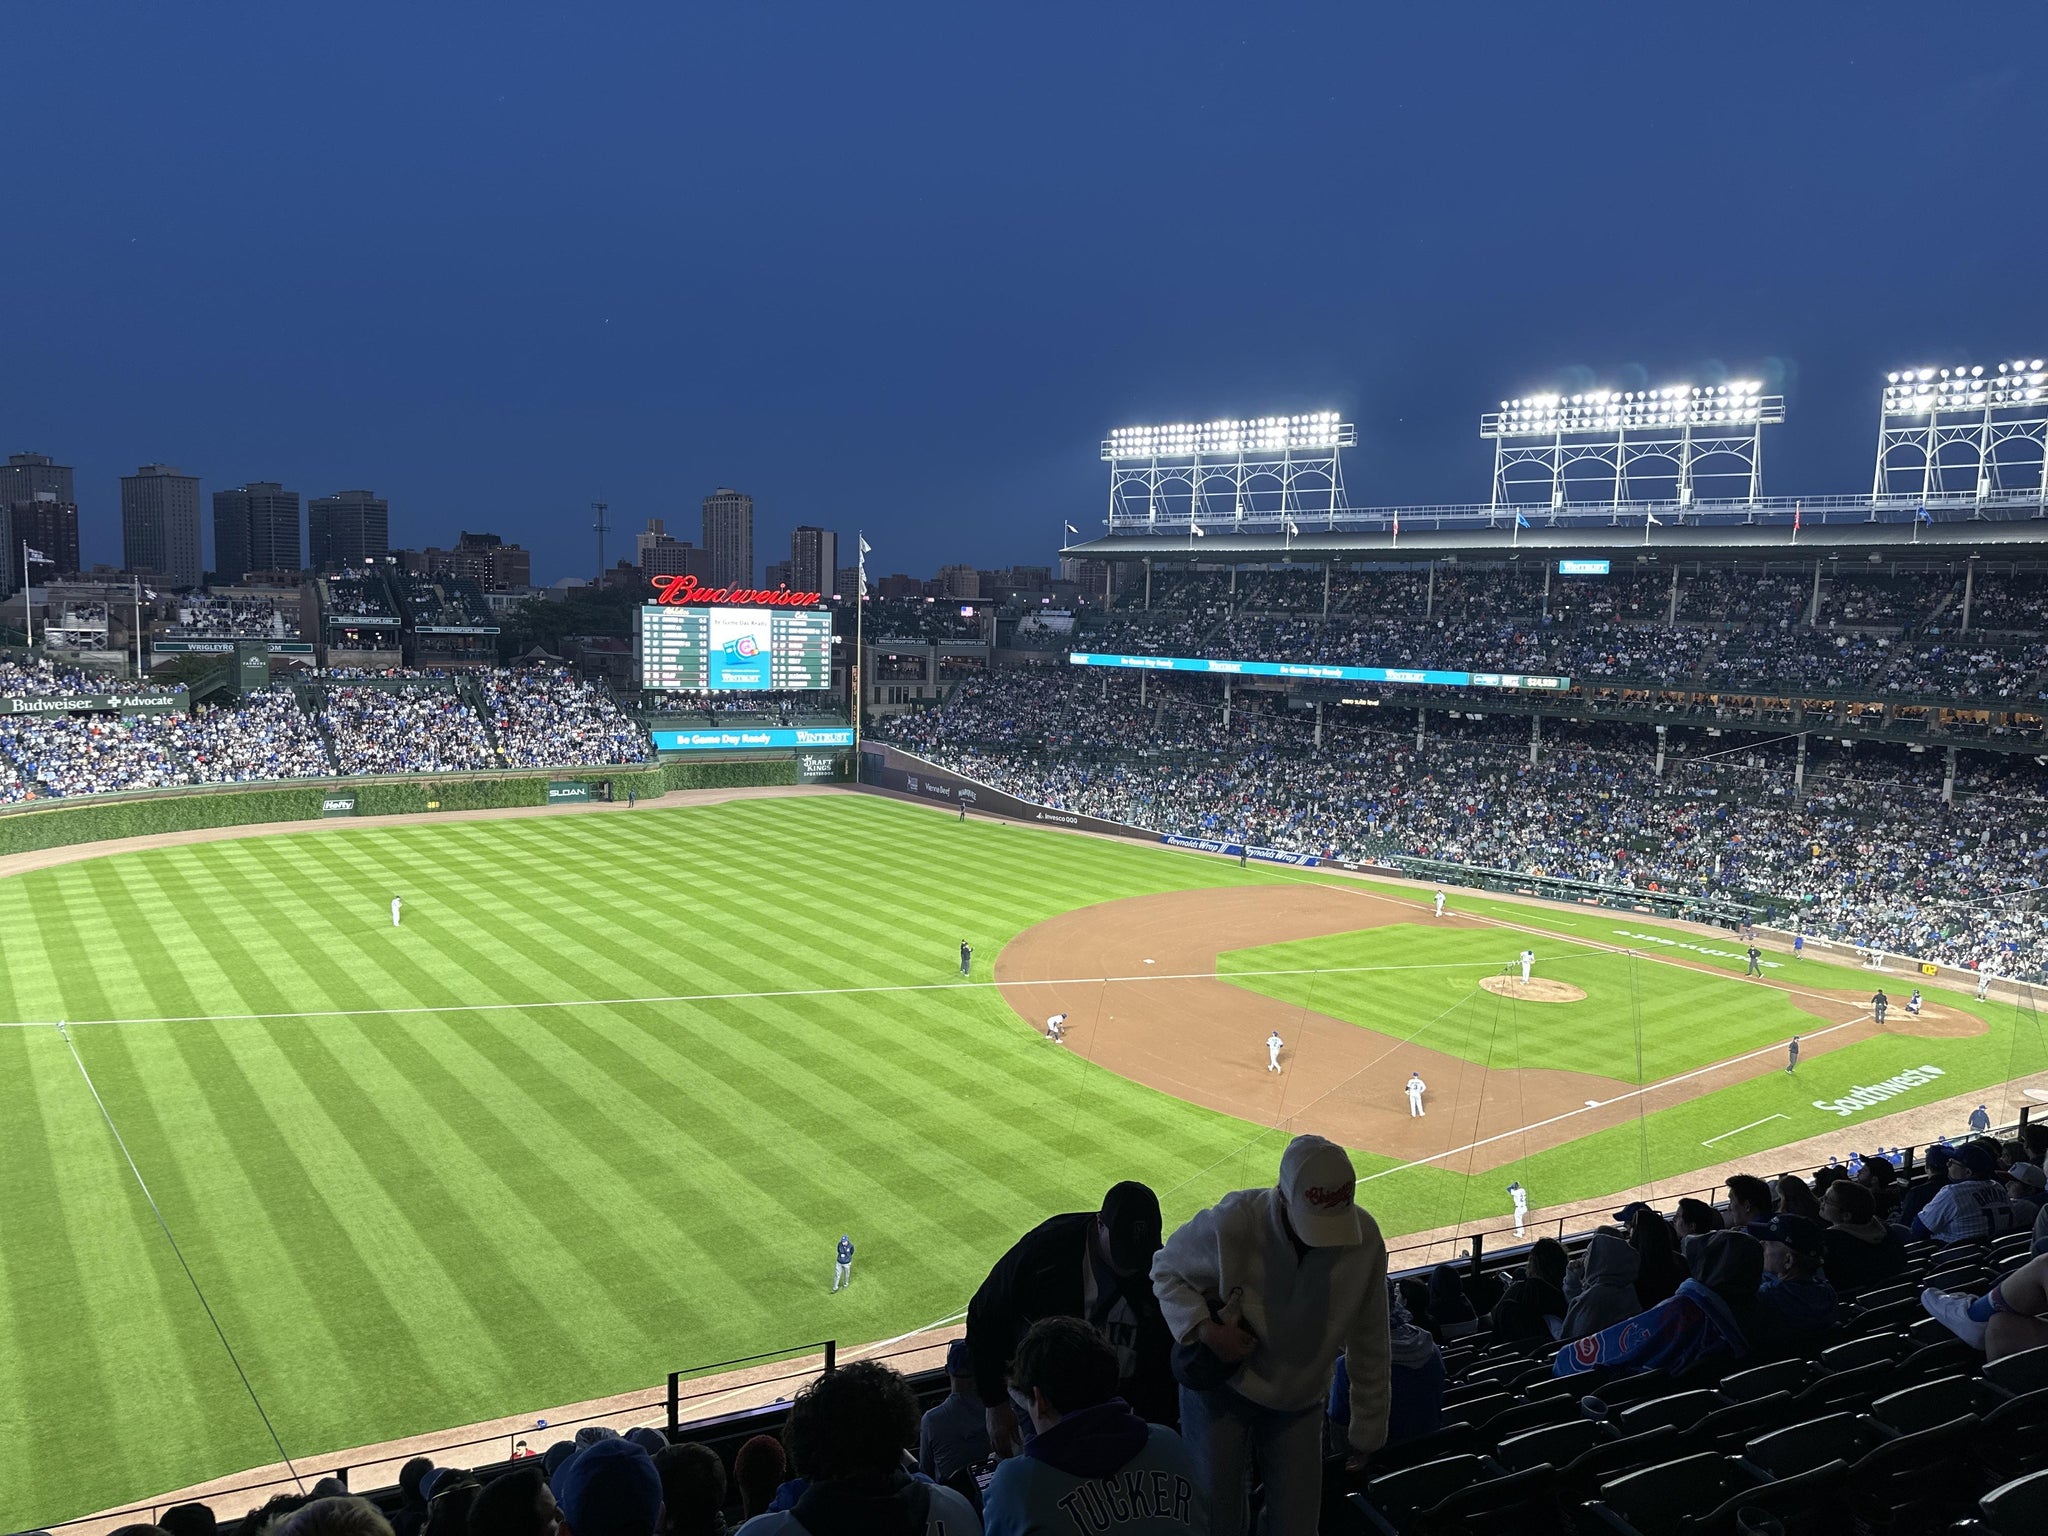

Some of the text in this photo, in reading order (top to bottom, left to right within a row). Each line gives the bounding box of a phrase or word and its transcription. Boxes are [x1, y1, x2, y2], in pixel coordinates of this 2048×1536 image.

[651, 575, 820, 606] Budweiser
[12, 698, 93, 712] Budweiser
[123, 696, 174, 707] Advocate
[677, 733, 771, 746] Be Game Day Ready
[803, 758, 833, 768] DRAFT
[549, 788, 587, 797] SLOAN
[325, 800, 352, 810] Hefty
[1044, 813, 1078, 825] Invesco QQQ
[1167, 836, 1219, 853] Reynolds Wrap
[1245, 847, 1298, 864] eynolds Wrap
[1812, 1068, 1938, 1117] Southwest
[1981, 1205, 2013, 1233] 17
[1057, 1469, 1192, 1536] TUCKER
